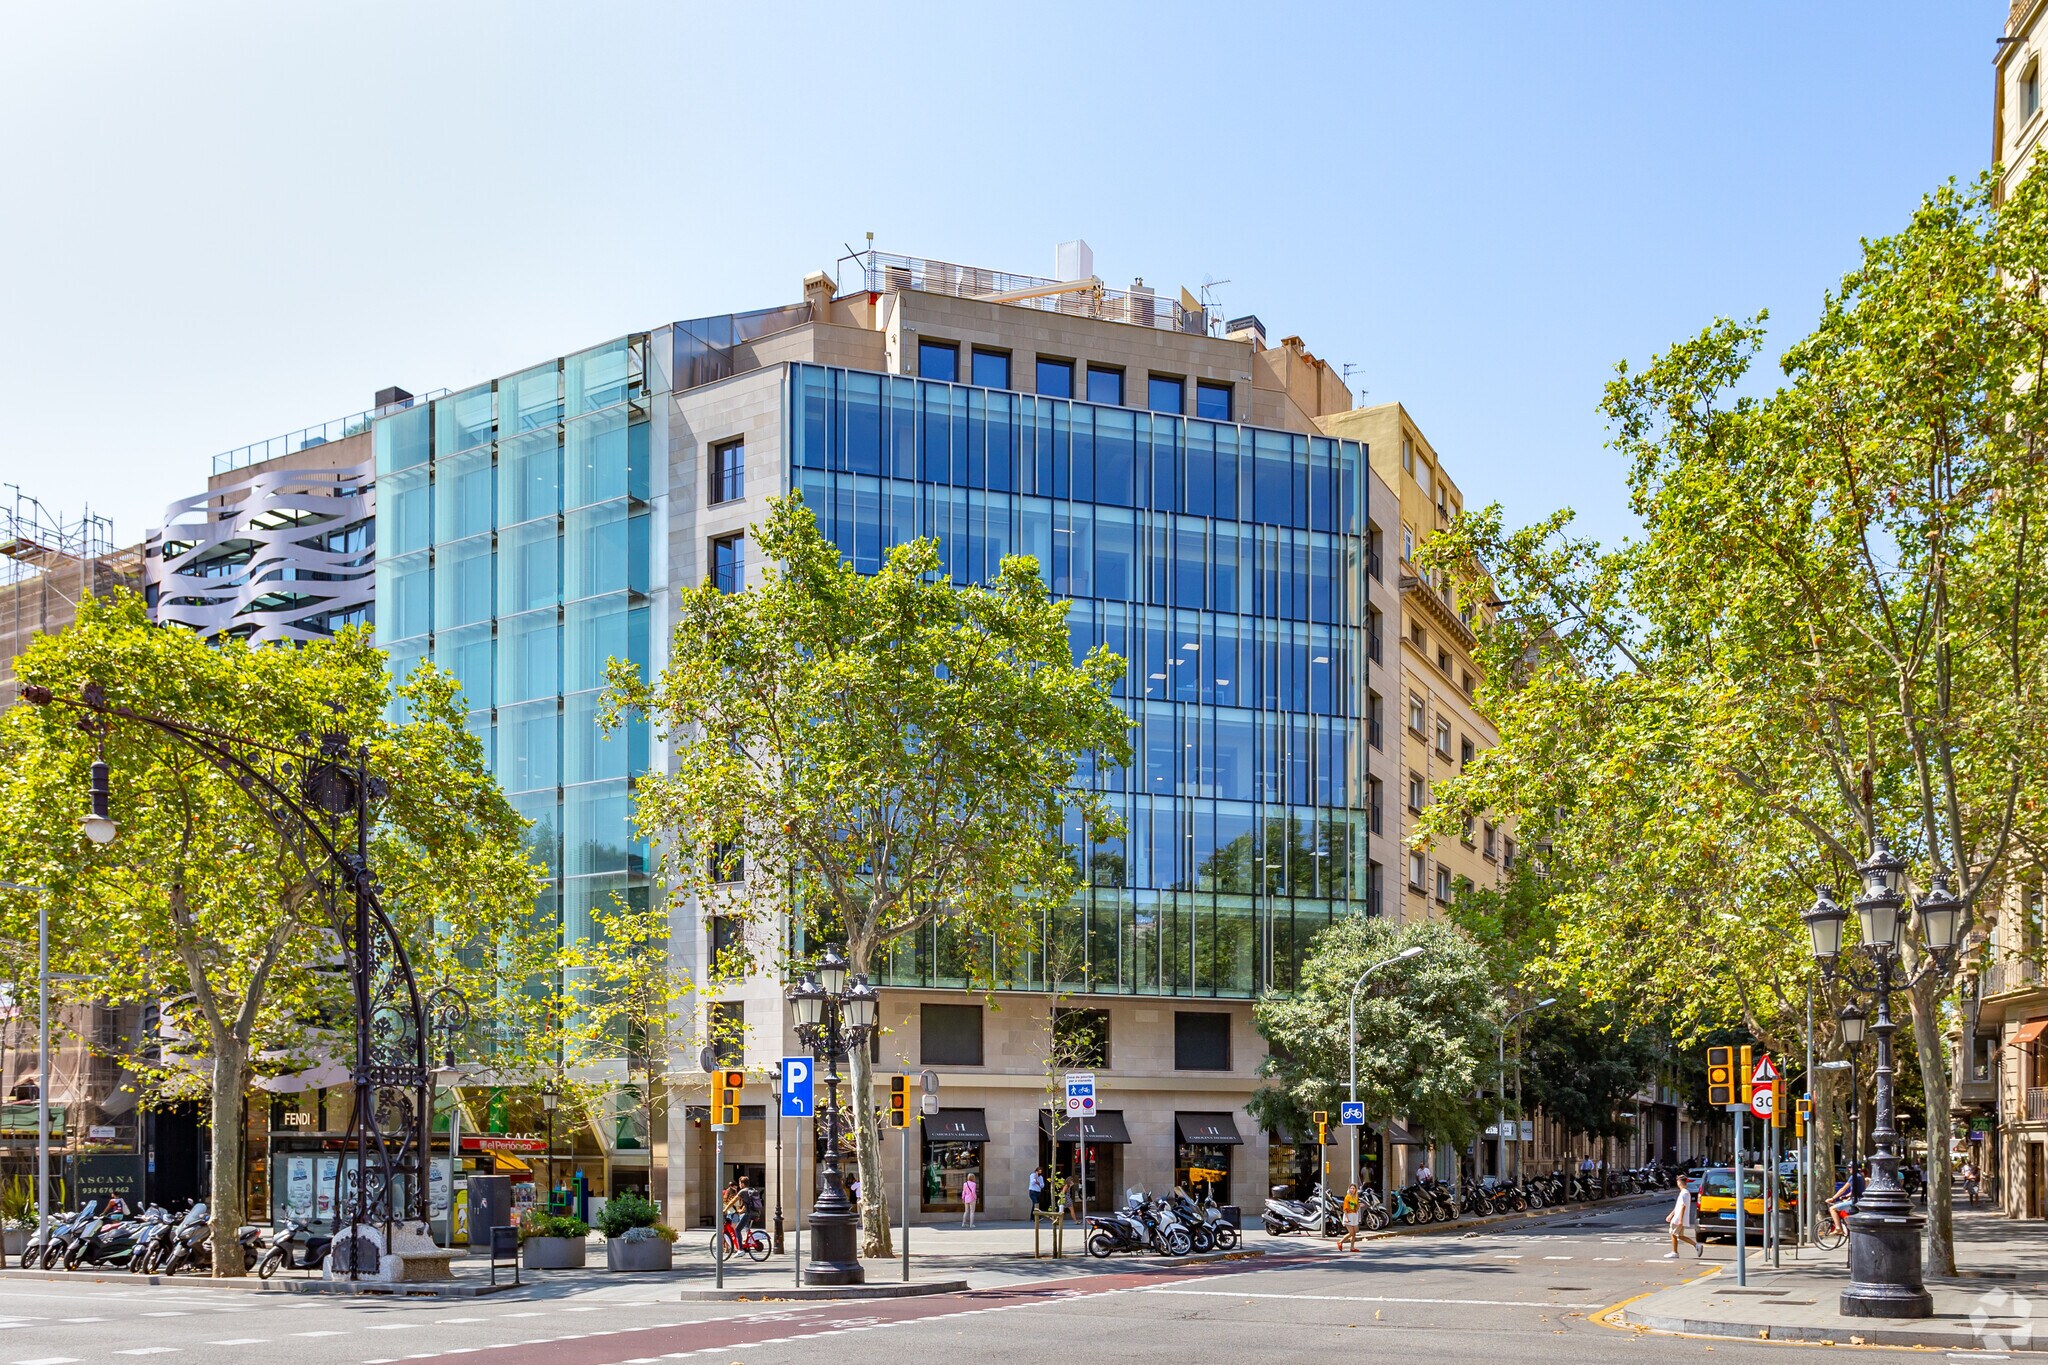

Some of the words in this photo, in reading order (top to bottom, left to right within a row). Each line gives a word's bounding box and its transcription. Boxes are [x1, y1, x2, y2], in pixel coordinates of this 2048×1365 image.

[787, 1061, 808, 1093] P
[284, 1112, 311, 1125] FENDI
[487, 1141, 495, 1149] el
[77, 1175, 134, 1184] ASCANA
